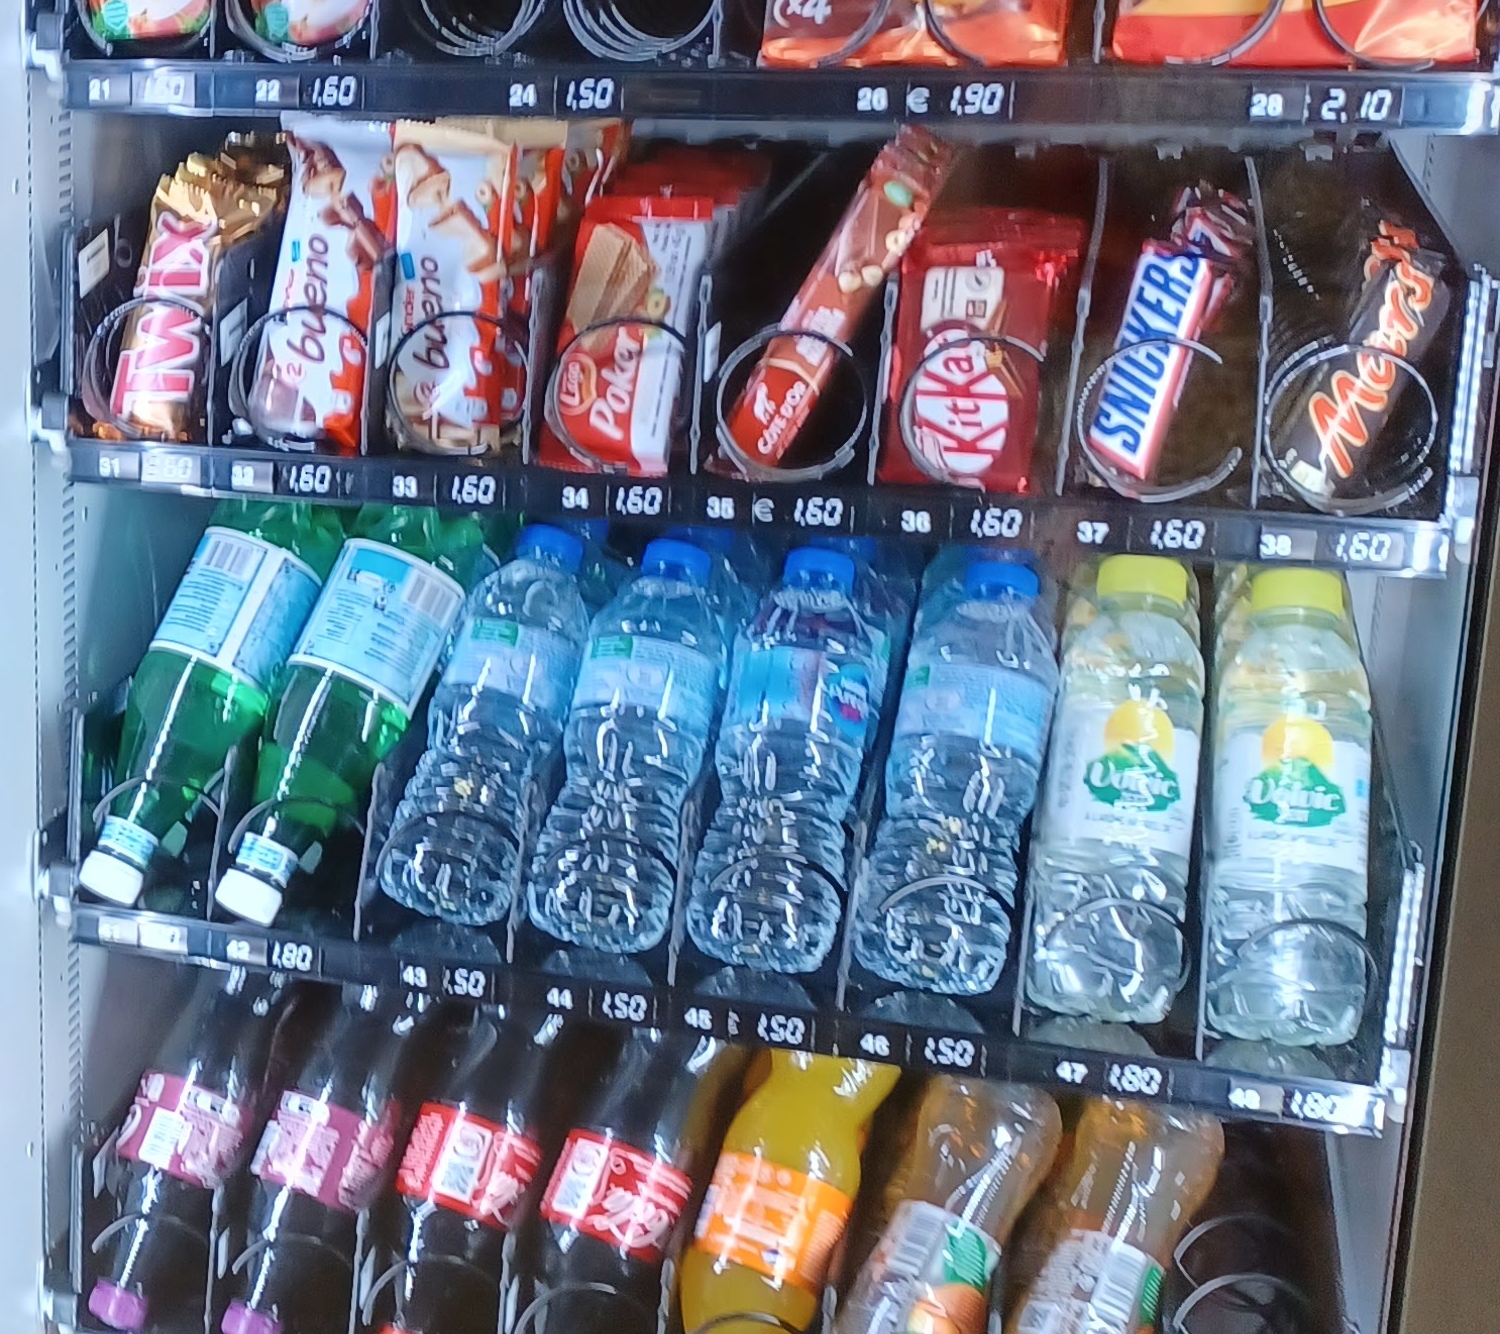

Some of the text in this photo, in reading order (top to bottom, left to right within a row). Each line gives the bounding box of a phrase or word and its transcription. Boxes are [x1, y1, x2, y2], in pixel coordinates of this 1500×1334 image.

[255, 78, 281, 103] 22
[110, 209, 220, 418] TWIX
[286, 233, 329, 362] bueno
[412, 255, 451, 369] bueno
[916, 332, 1006, 455] KitKa
